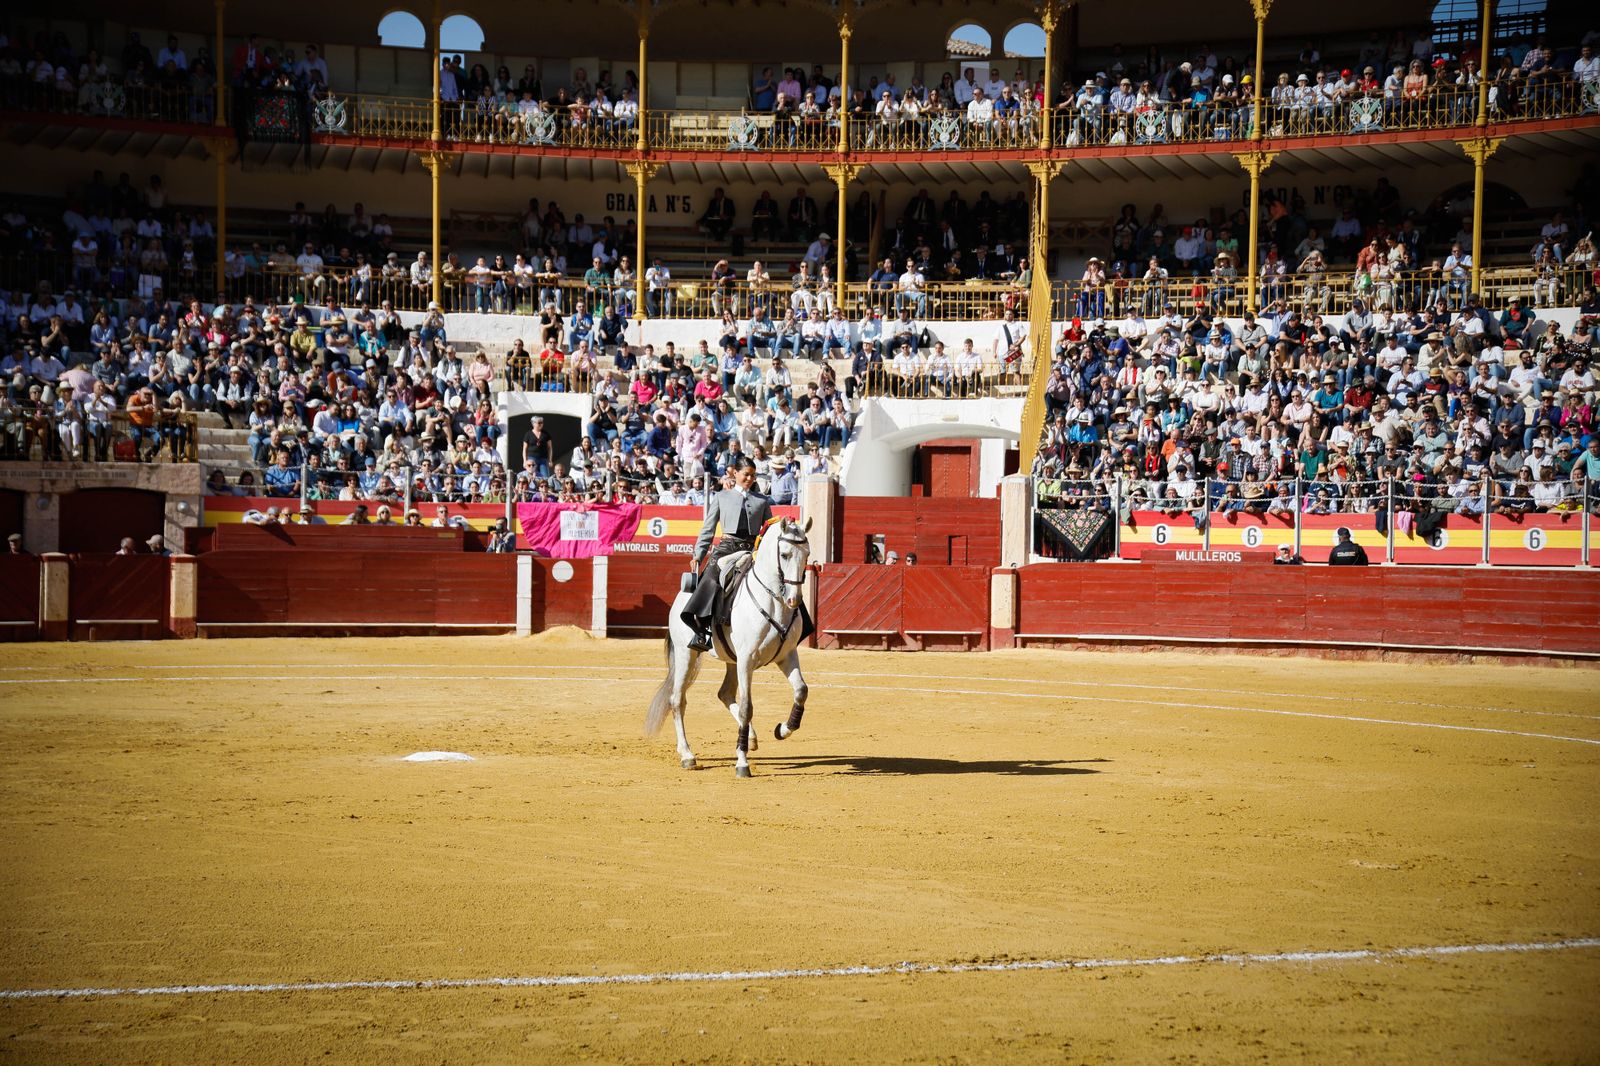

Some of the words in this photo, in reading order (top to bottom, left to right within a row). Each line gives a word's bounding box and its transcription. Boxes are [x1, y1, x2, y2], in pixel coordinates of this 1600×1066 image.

[606, 193, 657, 212] GRAA
[652, 519, 662, 537] 5
[1155, 525, 1166, 544] 6
[1247, 527, 1257, 546] 6
[613, 543, 660, 553] MAYORALES
[666, 543, 694, 553] MOZOS
[1529, 530, 1540, 549] 6
[1175, 550, 1242, 562] MULILLEROS
